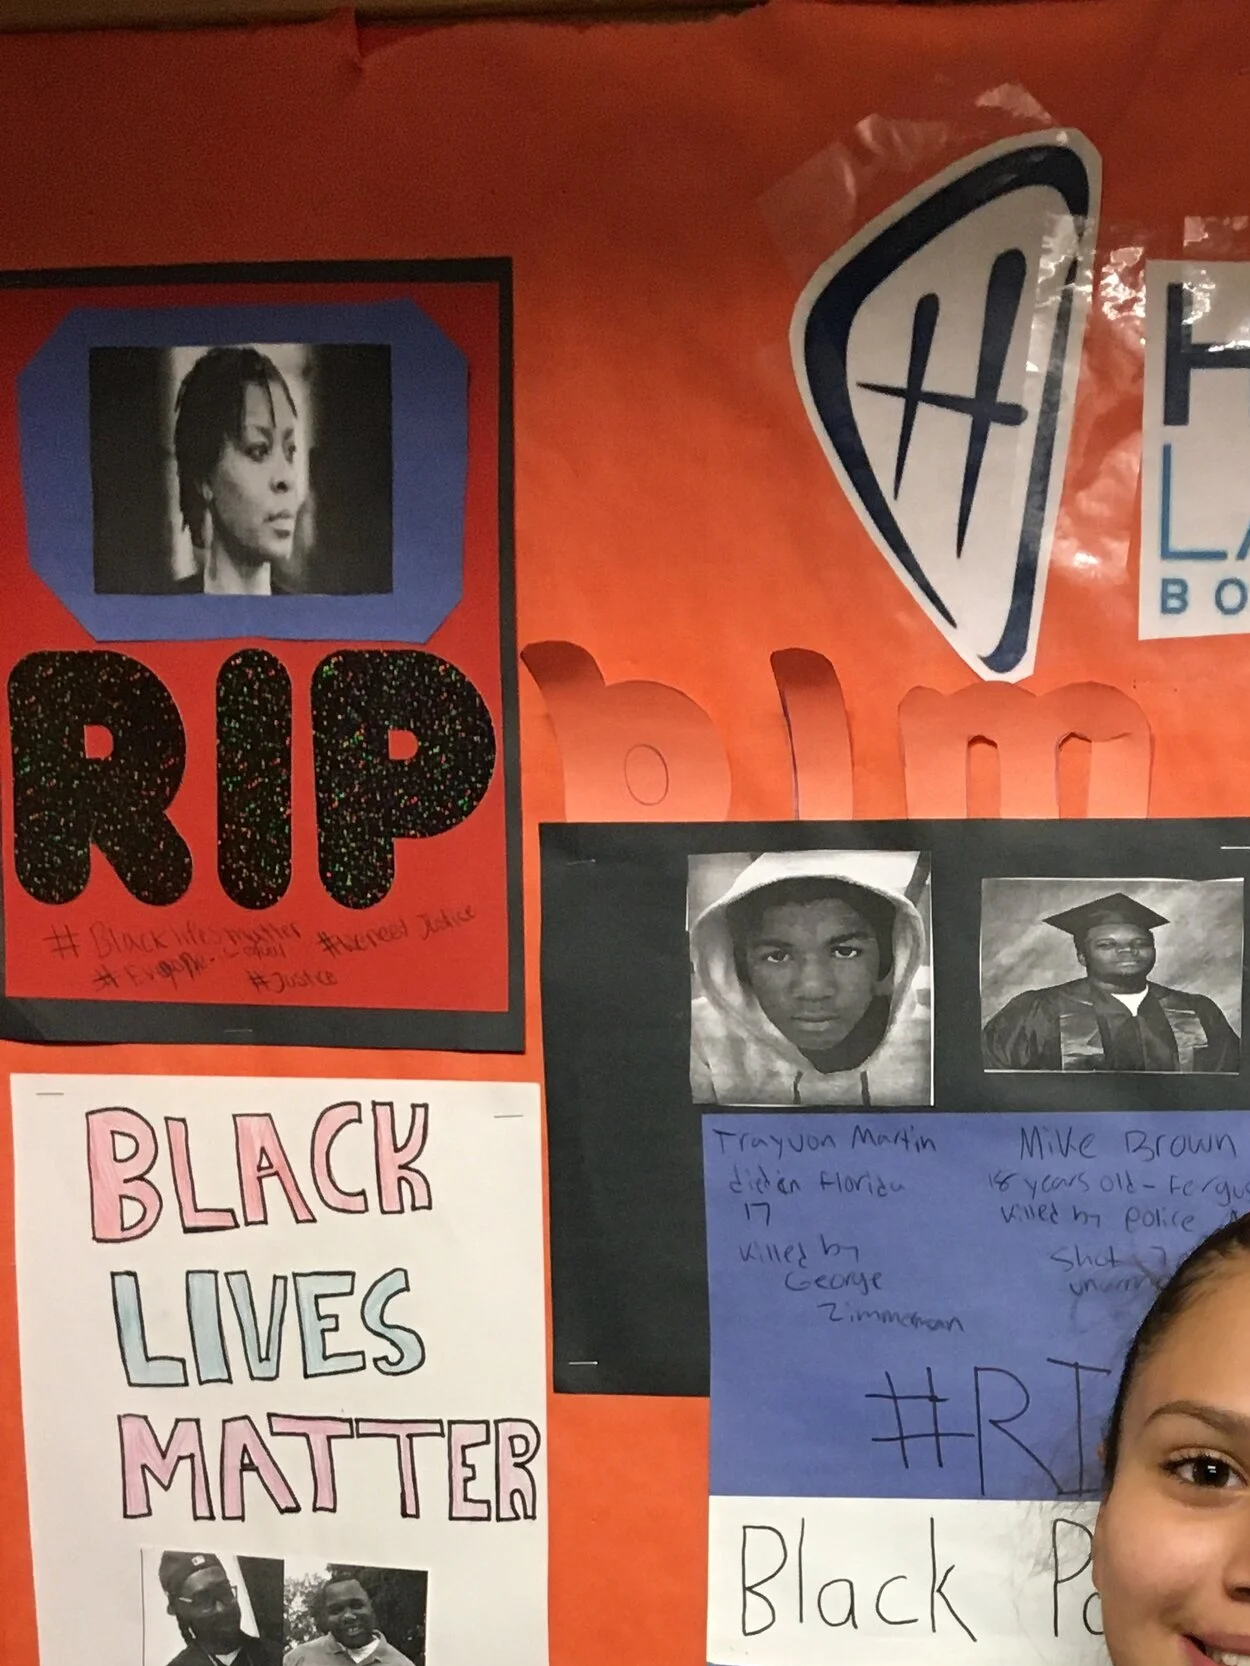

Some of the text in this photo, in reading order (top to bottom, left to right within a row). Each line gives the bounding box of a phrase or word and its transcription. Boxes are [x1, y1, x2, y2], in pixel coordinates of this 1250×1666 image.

[7, 648, 497, 910] RIP
[86, 1101, 433, 1243] BLACK
[851, 1123, 937, 1153] Martin
[1124, 1130, 1237, 1162] Brown
[744, 1201, 772, 1227] 17
[1023, 1172, 1090, 1197] years
[1100, 1172, 1135, 1195] old
[785, 1270, 883, 1294] George
[110, 1268, 427, 1388] LIVES
[117, 1413, 542, 1523] MATTER
[741, 1516, 978, 1643] Black
